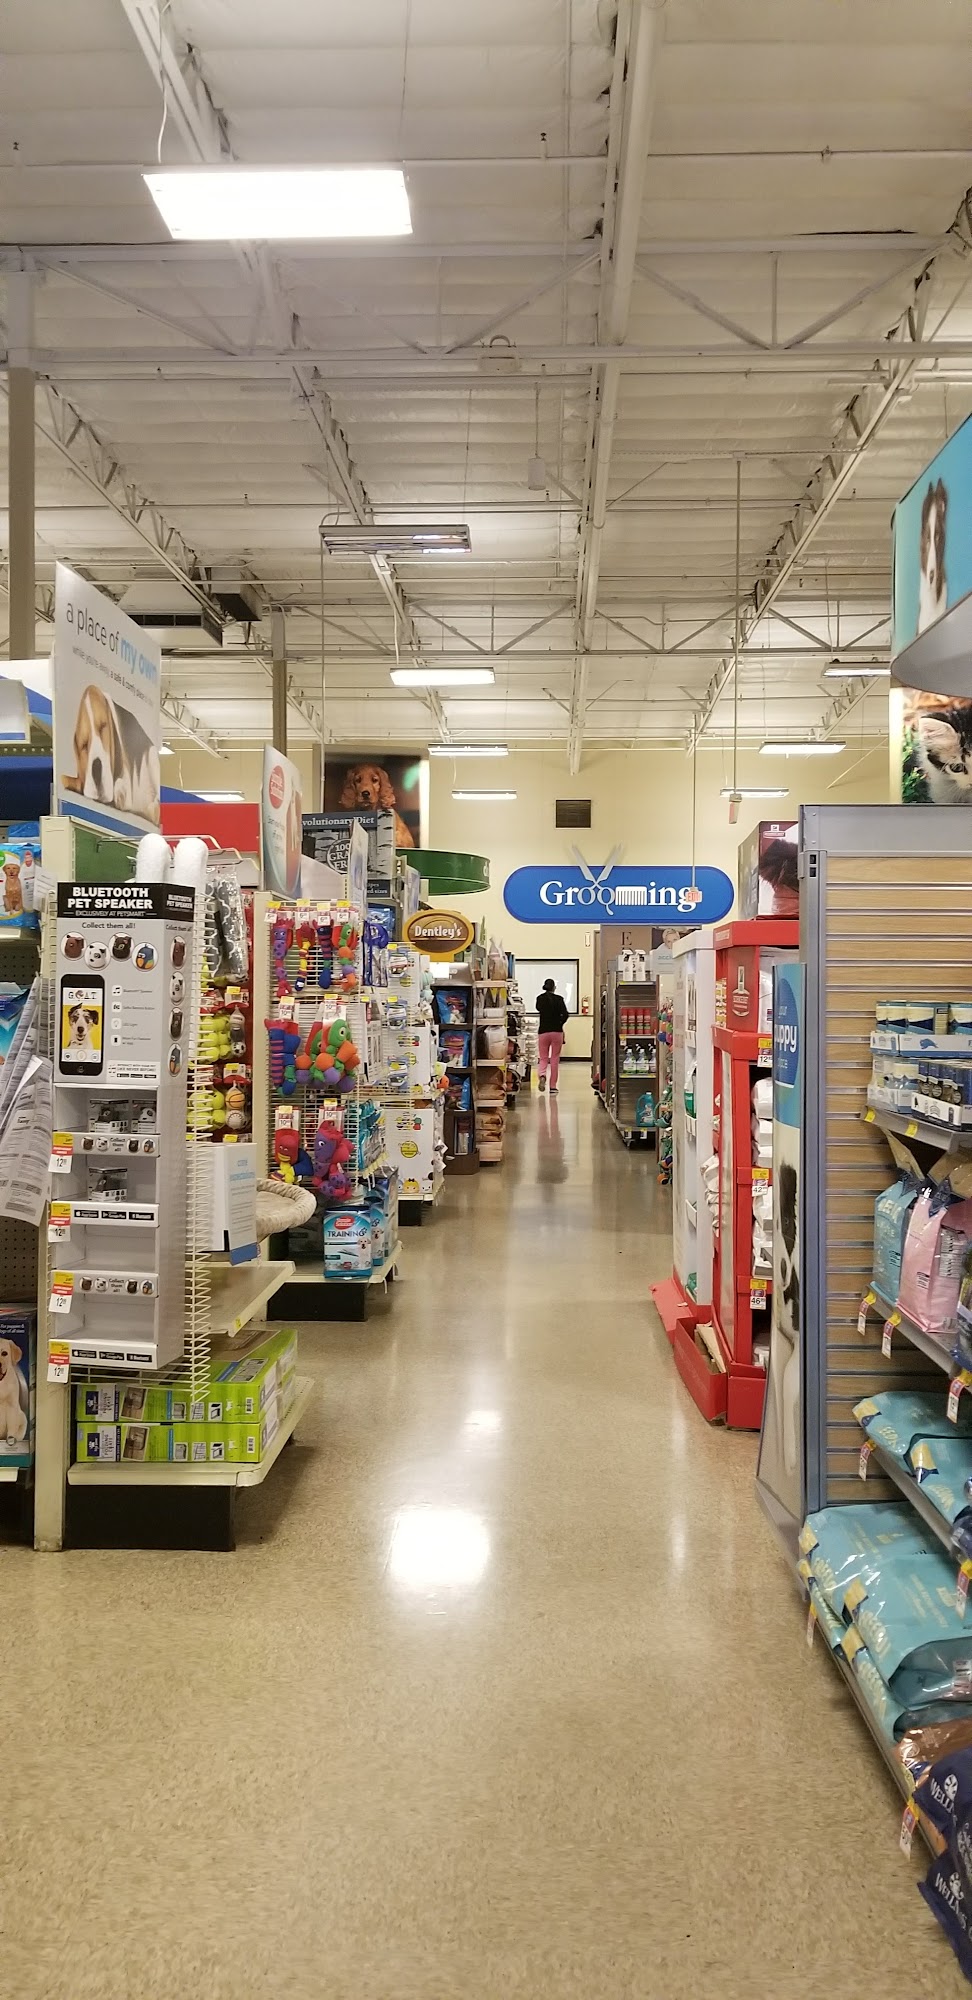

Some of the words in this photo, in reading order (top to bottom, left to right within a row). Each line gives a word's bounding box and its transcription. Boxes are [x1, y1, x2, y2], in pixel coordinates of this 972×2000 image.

[66, 603, 73, 624] a
[77, 608, 107, 646] place
[109, 631, 119, 655] of
[121, 638, 137, 674] my
[139, 654, 157, 687] own
[353, 816, 374, 824] Diet
[335, 843, 350, 852] 100
[334, 860, 347, 869] FR
[72, 886, 149, 898] BLUETOOTH
[540, 881, 697, 915] Grooming
[67, 898, 91, 909] PET
[95, 898, 153, 910] SPEAKER
[415, 923, 462, 939] Dentley's
[328, 1229, 365, 1237] TRAINING
